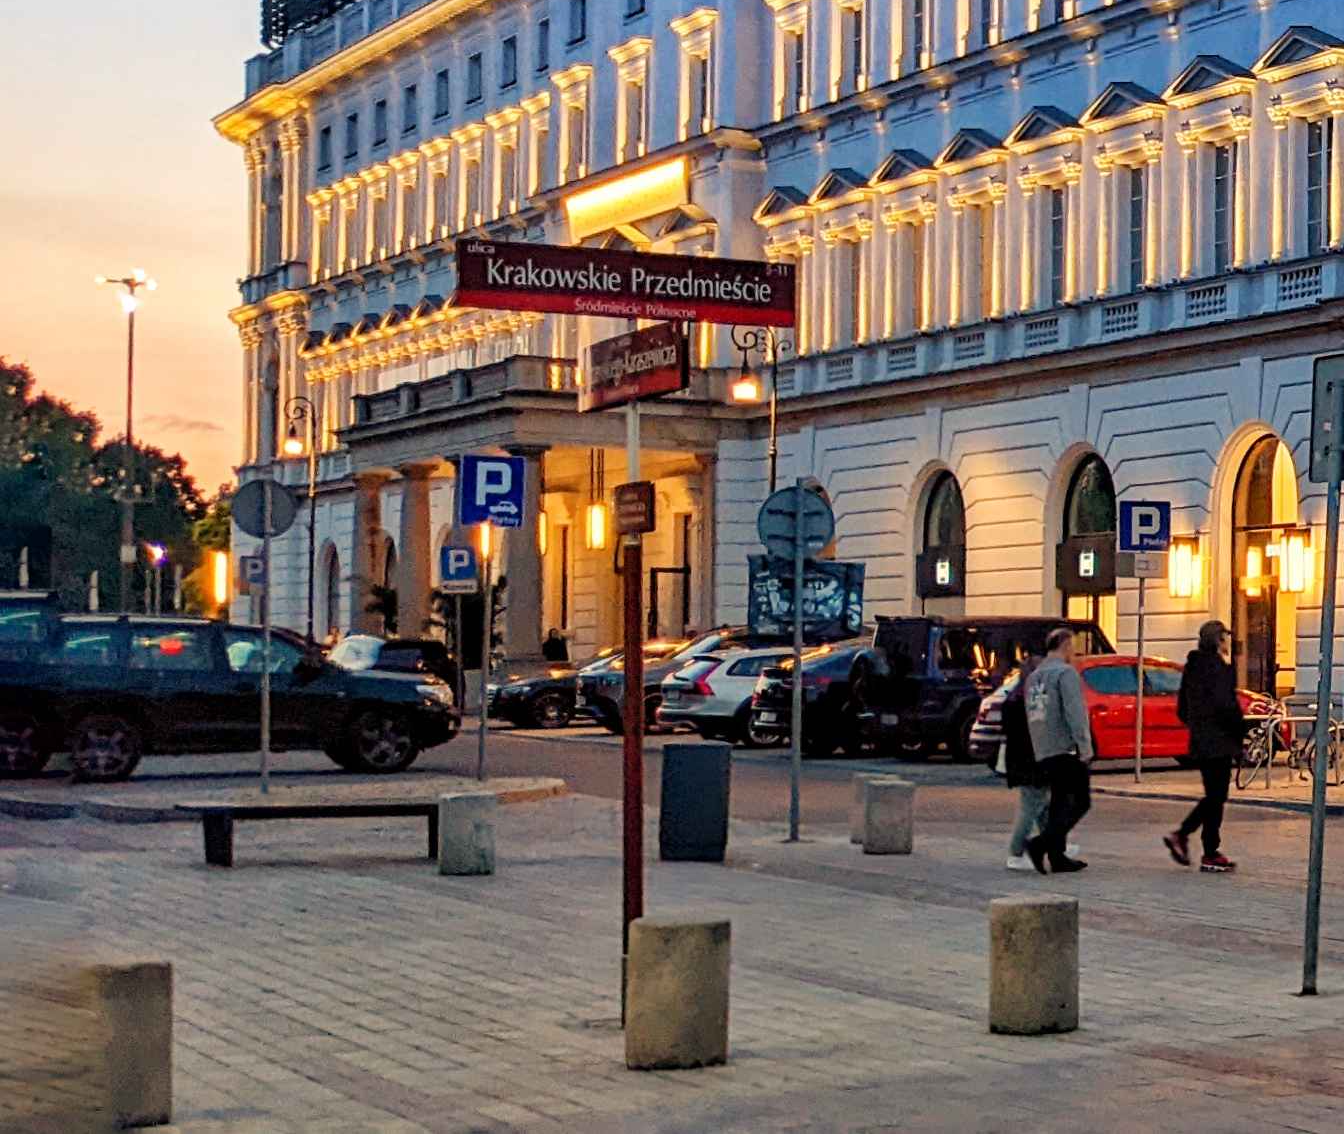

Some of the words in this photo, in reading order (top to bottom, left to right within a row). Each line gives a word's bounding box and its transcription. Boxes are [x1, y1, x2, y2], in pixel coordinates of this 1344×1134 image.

[467, 241, 495, 254] ulica
[486, 258, 622, 292] Krakowskie
[631, 267, 772, 303] Przedmieście
[574, 298, 641, 315] Śródmieście
[475, 461, 512, 506] P
[1131, 506, 1160, 546] P
[449, 549, 470, 575] P
